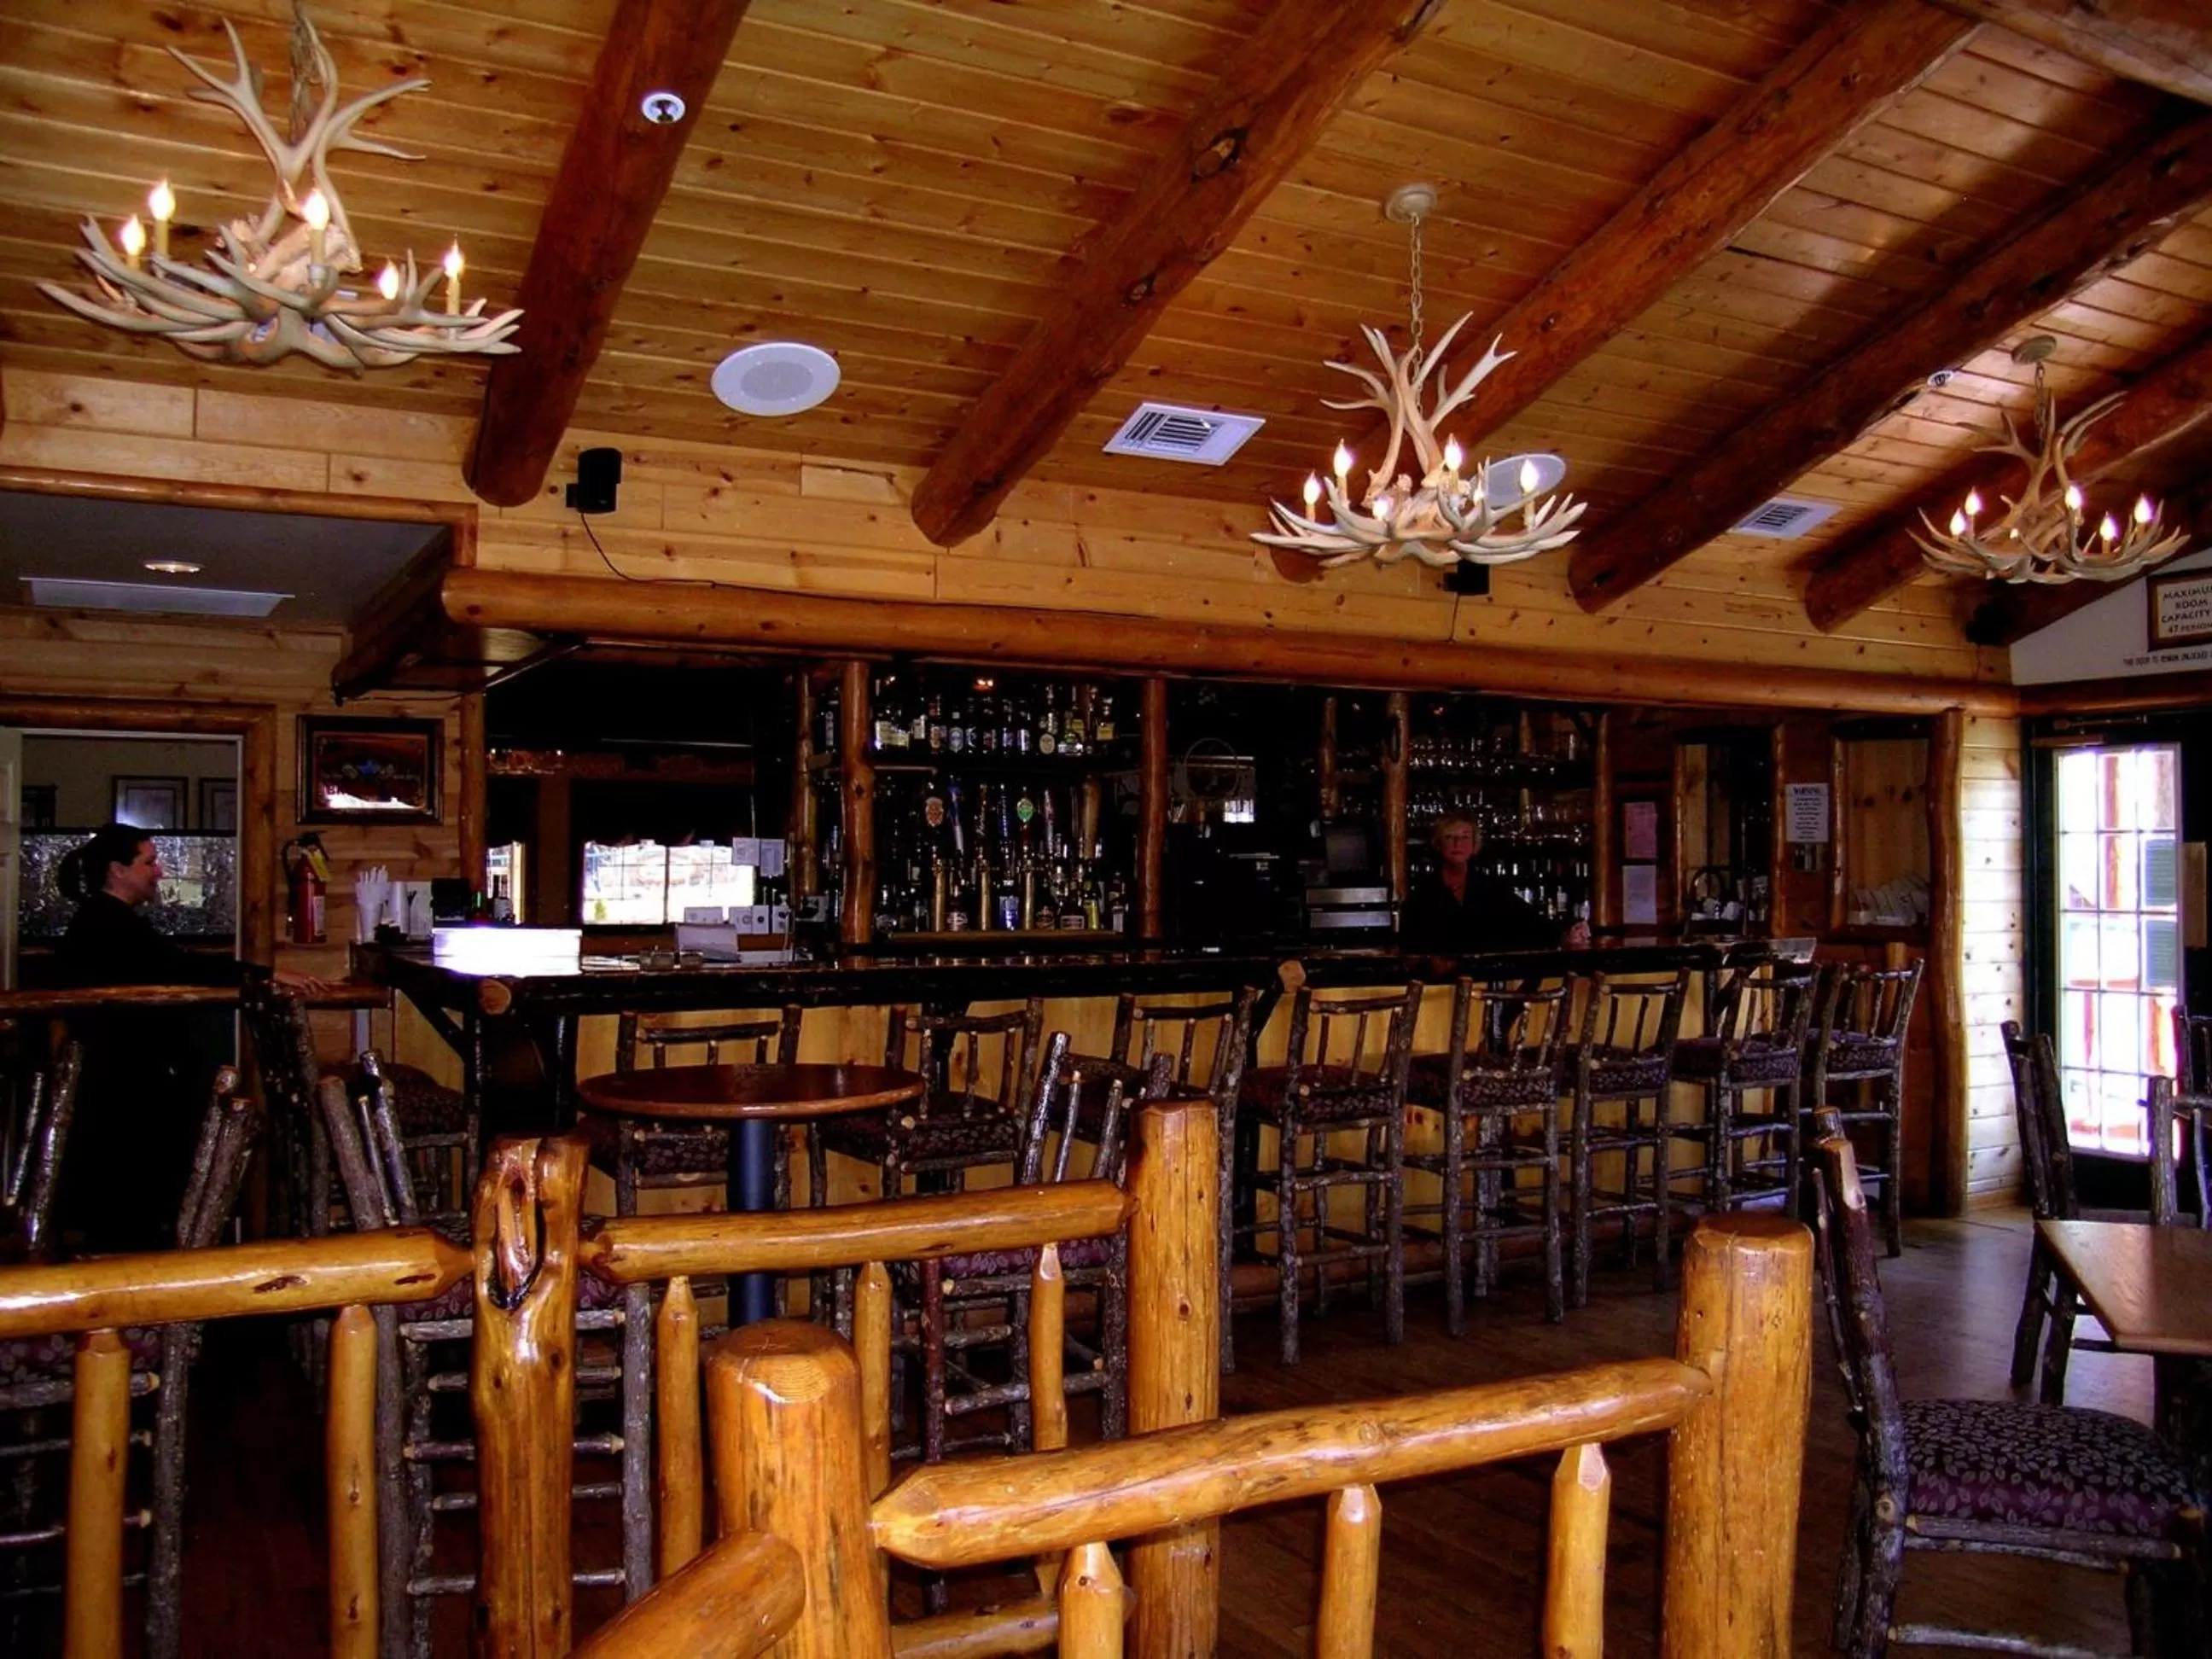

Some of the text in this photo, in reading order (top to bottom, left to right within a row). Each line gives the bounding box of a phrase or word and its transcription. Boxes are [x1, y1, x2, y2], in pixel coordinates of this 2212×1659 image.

[2163, 586, 2212, 600] MAXIMU
[2175, 599, 2208, 609] ROOM
[2162, 609, 2209, 623] CAPACITY
